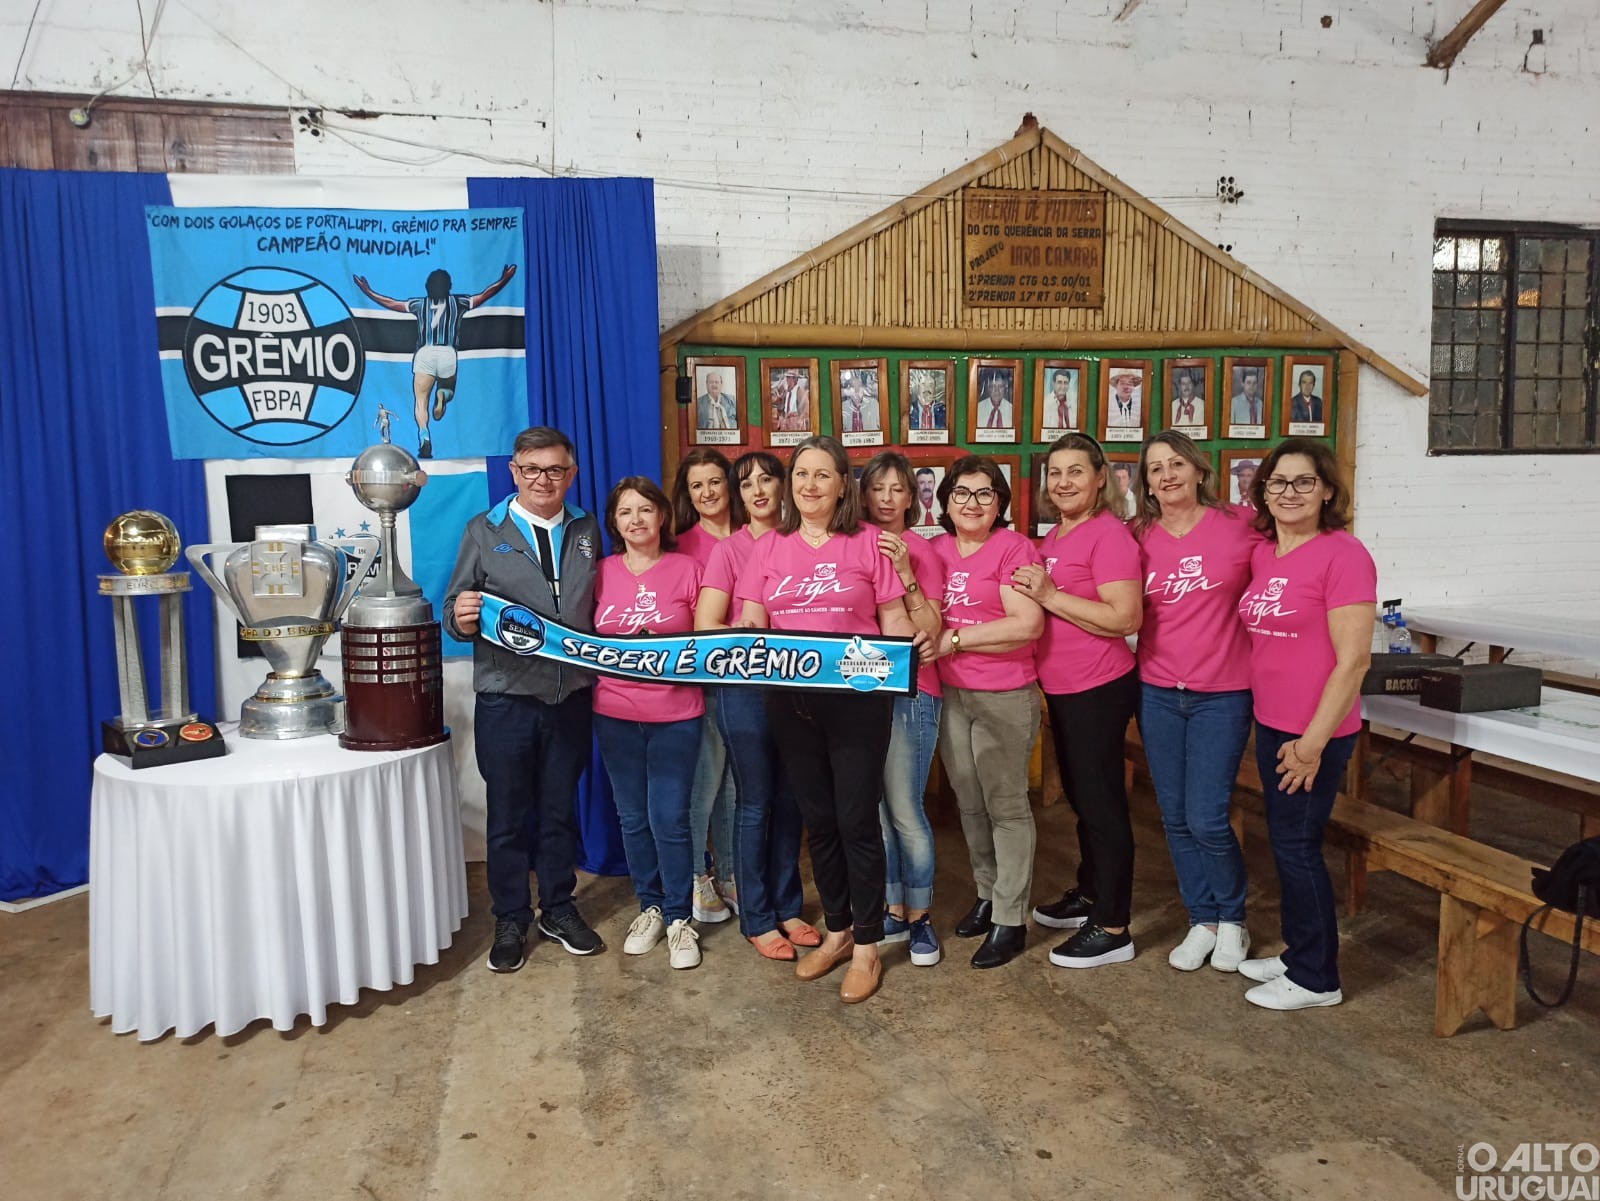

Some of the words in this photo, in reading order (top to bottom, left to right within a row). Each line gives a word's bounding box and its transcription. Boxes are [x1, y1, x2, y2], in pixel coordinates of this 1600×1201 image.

[184, 216, 215, 229] DOIS
[219, 216, 281, 232] GOLAÇOS
[285, 216, 302, 229] DE
[443, 218, 467, 232] PRA
[471, 216, 518, 231] SEMPRE
[967, 224, 980, 236] DO
[983, 225, 1000, 237] CTG
[1004, 225, 1053, 238] QUERÊNCIA
[1056, 227, 1069, 238] DA
[1072, 227, 1101, 239] SERRA
[257, 232, 342, 253] CAMPEÃO
[346, 237, 436, 257] MUNDIAL!"
[969, 241, 1005, 271] PROJETO
[1020, 275, 1038, 287] CTG
[247, 301, 298, 325] 1903
[430, 301, 444, 329] 7
[193, 332, 356, 382] GRÊMIO
[252, 389, 302, 412] FBPA
[766, 575, 855, 607] Liga
[1143, 571, 1224, 604] Liga
[596, 604, 676, 635] Liga
[562, 637, 672, 677] SEBERI
[674, 638, 699, 675] É
[703, 636, 823, 681] GRÊMIO
